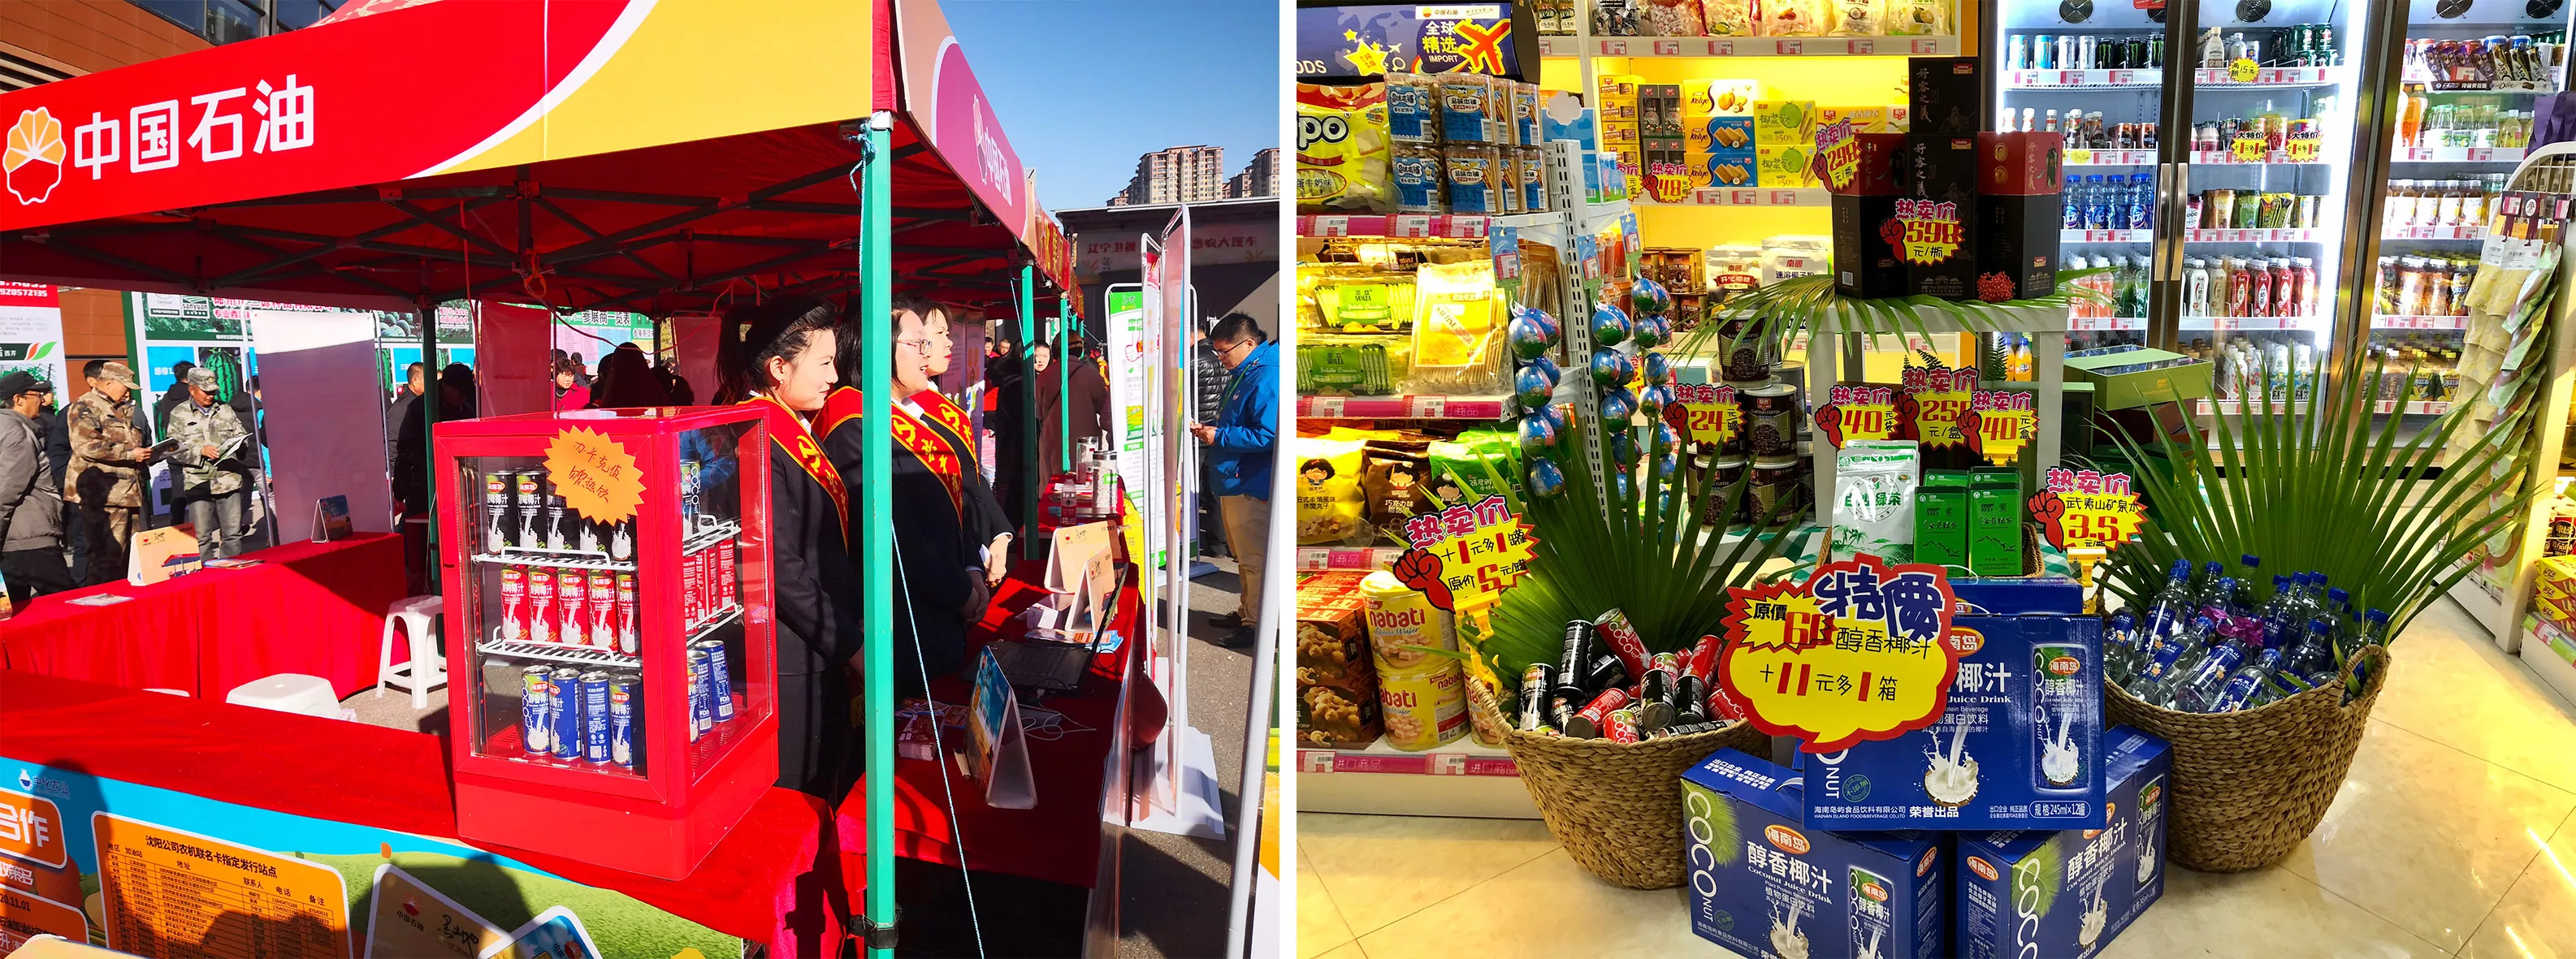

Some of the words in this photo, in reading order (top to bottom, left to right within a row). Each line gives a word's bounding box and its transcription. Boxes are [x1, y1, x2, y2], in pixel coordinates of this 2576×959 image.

[1426, 20, 1456, 35] 全球
[1422, 37, 1457, 54] 精选
[1429, 54, 1458, 63] IMPORT
[74, 74, 315, 180] 中国石油
[1816, 119, 1852, 152] 热卖价
[2237, 132, 2264, 140] 大特价
[1827, 141, 1859, 171] 298
[1652, 163, 1687, 175] 热卖价
[1659, 179, 1681, 197] 48
[1895, 199, 1956, 221] 热卖价
[1907, 222, 1961, 244] 598
[1903, 367, 1979, 393] 热卖价
[1676, 385, 1735, 404] 热卖价
[1831, 387, 1891, 406] 热卖价
[1972, 391, 2031, 411] 热卖价
[1690, 410, 1722, 431] 24
[1844, 409, 1882, 434] 40
[1982, 417, 2017, 440] 40
[1929, 426, 1961, 438] 元/盒
[2047, 469, 2132, 496] 热卖价
[2065, 496, 2140, 513] 武夷山矿泉水
[1407, 497, 1511, 551] 热卖价
[2069, 514, 2119, 542] 3.5
[1753, 603, 1786, 621] 原價
[1814, 566, 1945, 641] 特價
[1370, 608, 1425, 629] nabati
[1835, 627, 1931, 660] 醇香椰汁
[1950, 635, 1977, 650] 南岛
[2050, 661, 2077, 672] 海南岛
[2045, 679, 2084, 696] 醇香椰汁
[1814, 806, 1906, 814] 海南岛屿食品饮料有限公司
[1909, 806, 1959, 819] 荣誉出品
[1768, 827, 1807, 853] 海南岛
[2067, 817, 2128, 883] 醇香椰汁
[145, 835, 278, 879] 沈阳公司农机联名卡指定发行站点
[1747, 840, 1832, 894] 醇香椰汁
[1747, 866, 1782, 884] Coconut
[1783, 879, 1806, 894] Juice
[1808, 891, 1833, 905] Drink
[396, 910, 424, 932] 中国石油
